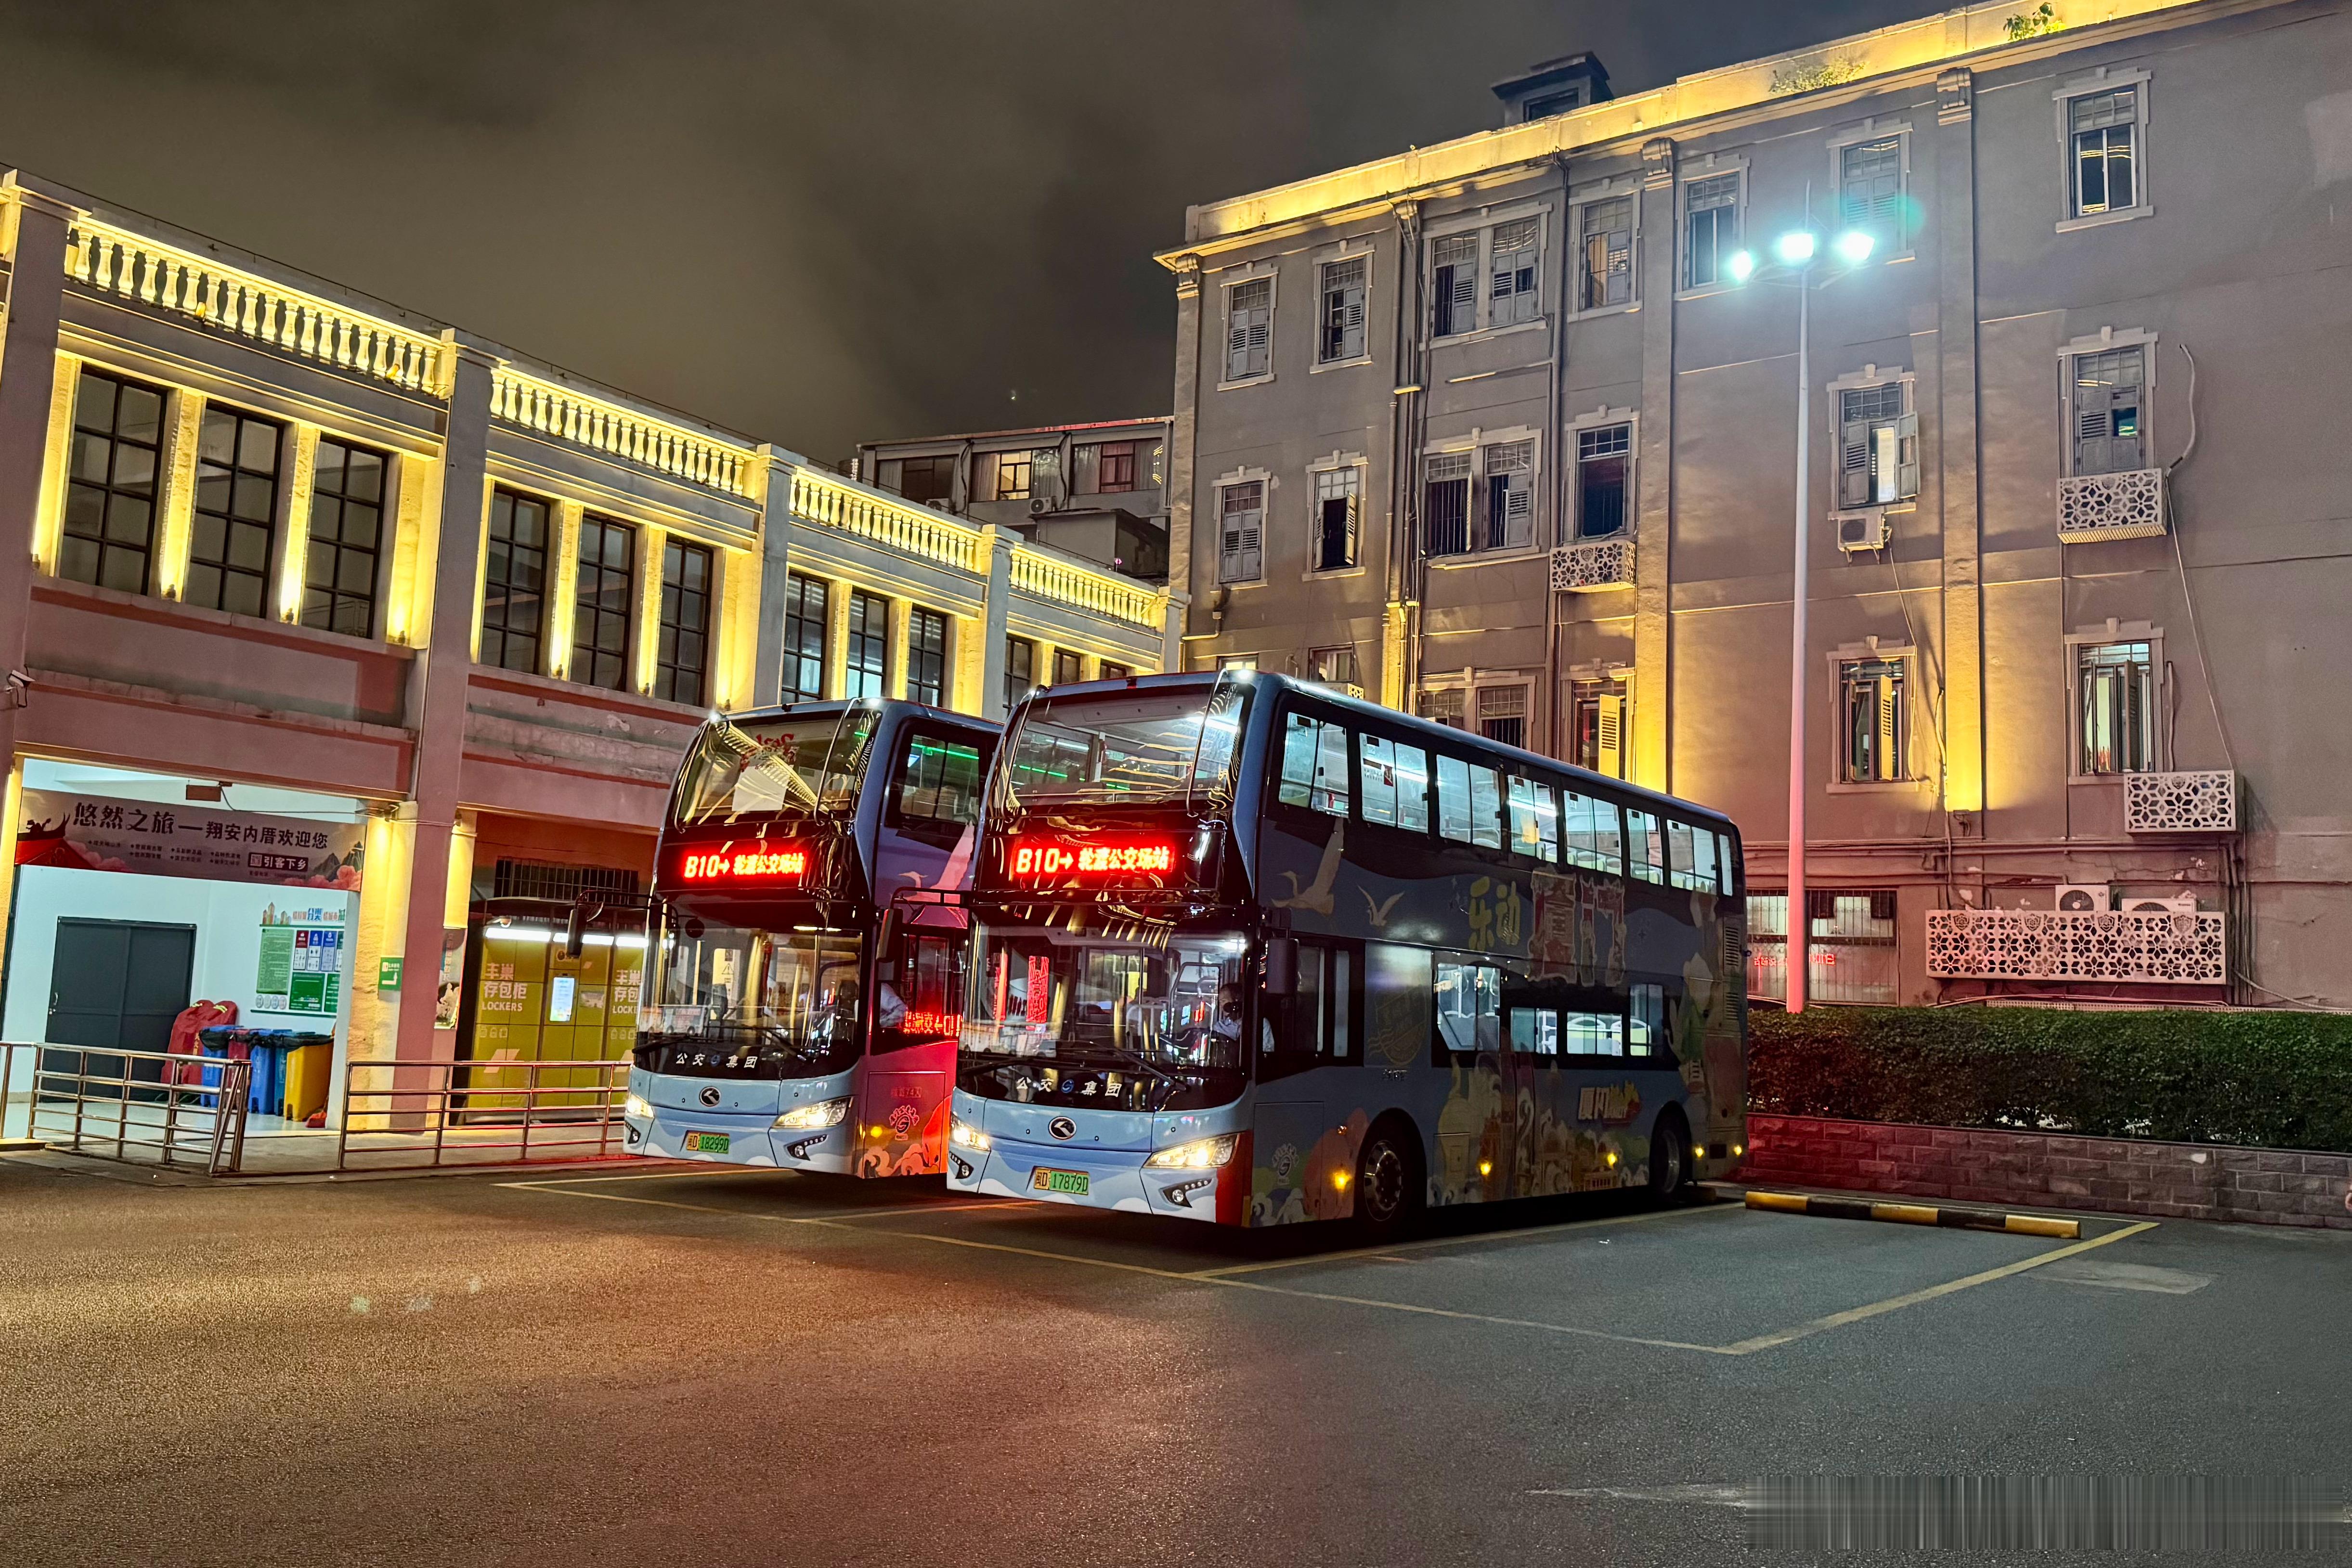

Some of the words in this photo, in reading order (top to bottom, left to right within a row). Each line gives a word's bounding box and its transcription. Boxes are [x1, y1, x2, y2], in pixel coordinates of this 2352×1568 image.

[264, 856, 306, 870] 引客下乡
[684, 855, 720, 878] B10
[1016, 848, 1059, 873] B10
[485, 962, 514, 980] 丰巢
[484, 981, 528, 999] 存包柜
[482, 1001, 522, 1011] LOCKERS
